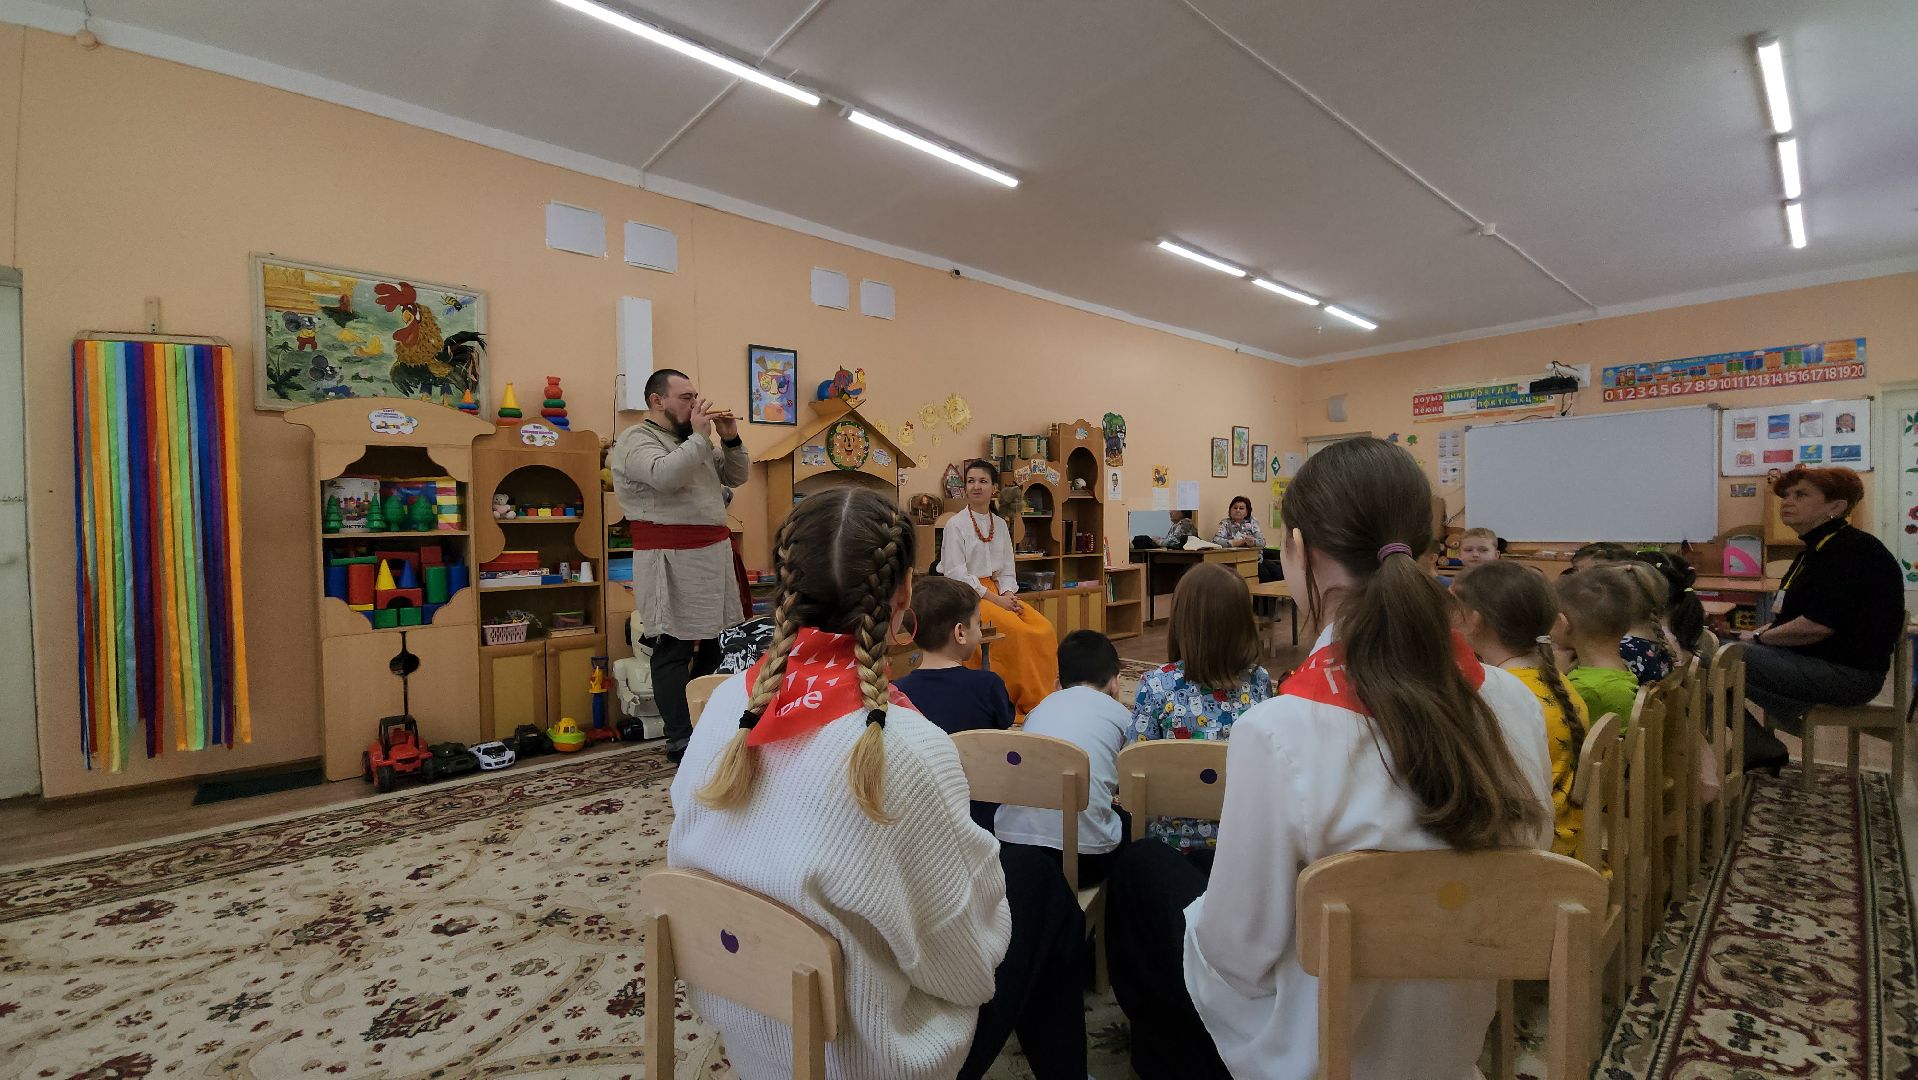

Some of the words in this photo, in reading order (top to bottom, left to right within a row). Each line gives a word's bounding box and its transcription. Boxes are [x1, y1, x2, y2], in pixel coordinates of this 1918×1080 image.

[1604, 390, 1614, 400] 0
[1617, 389, 1624, 400] 1
[1626, 388, 1636, 399] 2
[1637, 387, 1646, 398] 3
[1648, 386, 1658, 396] 4
[1660, 384, 1669, 395] 5
[1671, 383, 1681, 394] 6
[1683, 382, 1693, 393] 7
[1695, 380, 1705, 392] 8
[1707, 379, 1718, 390] 9
[1720, 378, 1731, 388] 10
[1733, 377, 1743, 387] 11
[1745, 375, 1757, 387] 12
[1758, 374, 1770, 386] 13
[1771, 373, 1782, 384] 14
[1785, 372, 1796, 383] 15
[1798, 370, 1809, 382] 16
[1811, 369, 1822, 380] 17
[1824, 367, 1837, 379] 18
[1839, 366, 1850, 378] 19
[1851, 365, 1865, 377] 20
